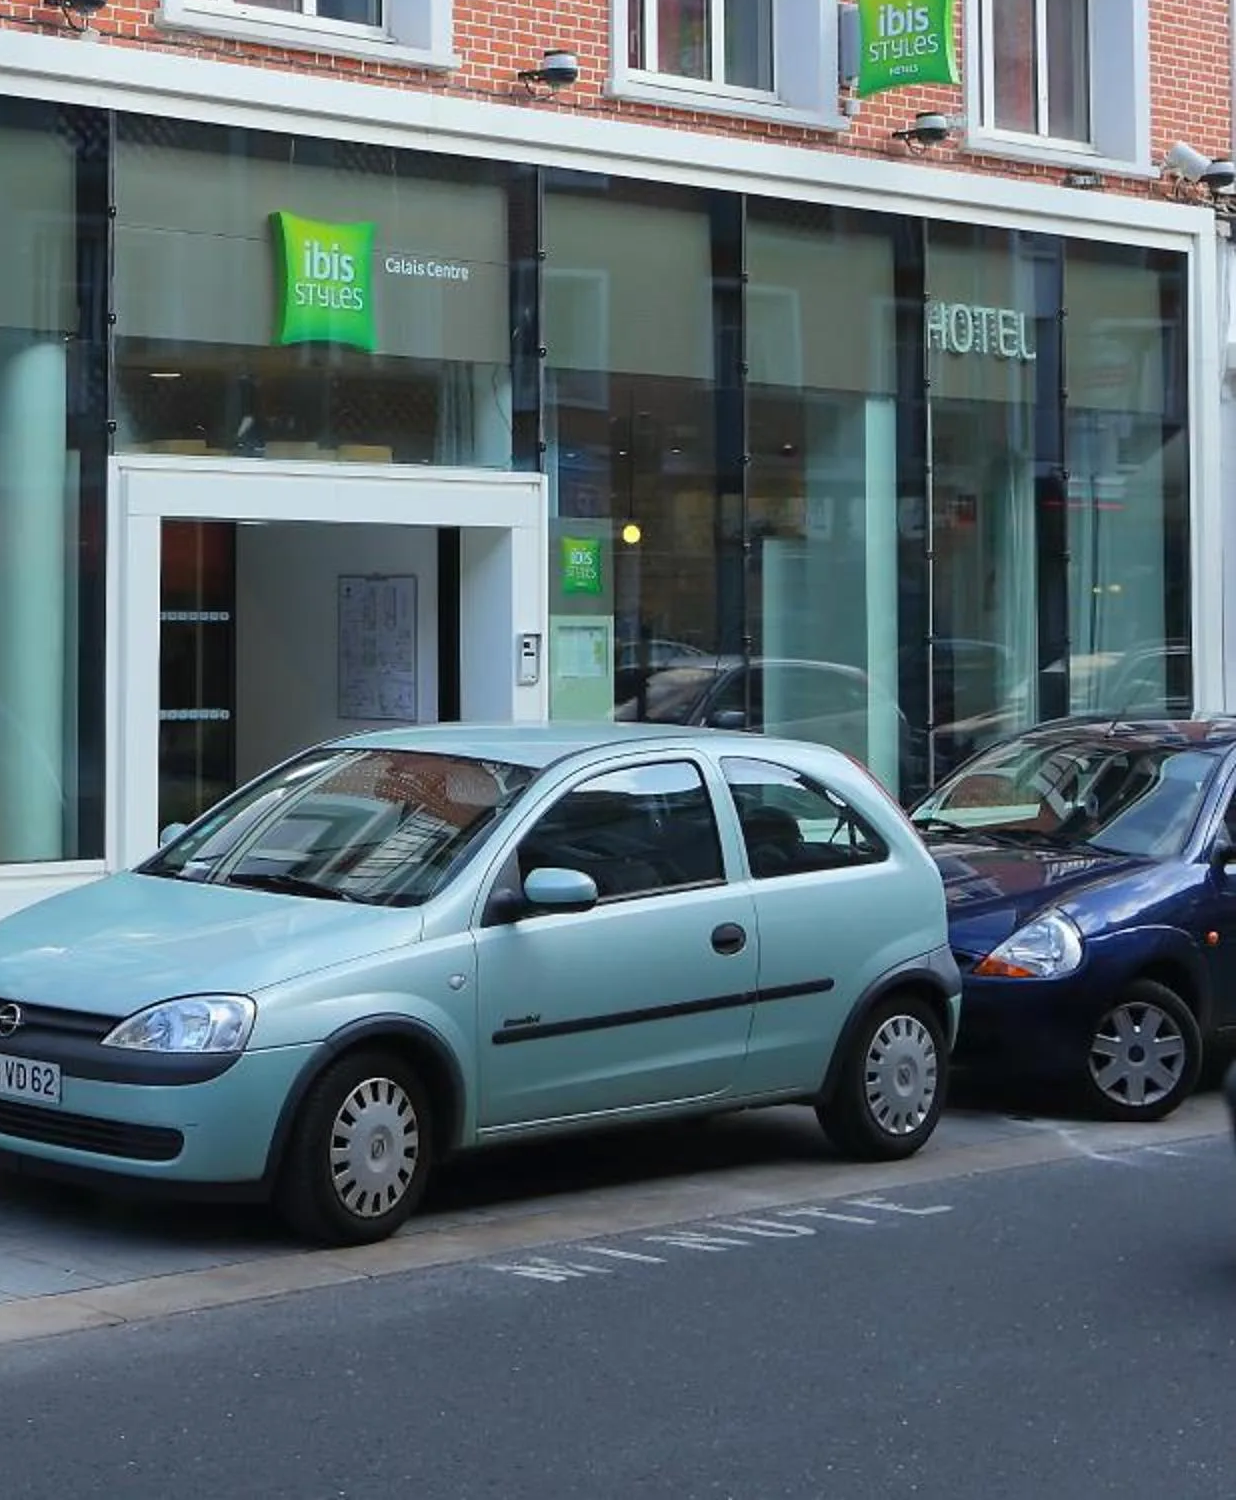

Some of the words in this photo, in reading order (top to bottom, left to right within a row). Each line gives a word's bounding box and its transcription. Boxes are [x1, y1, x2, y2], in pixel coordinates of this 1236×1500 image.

[879, 1, 929, 37] ibis
[303, 241, 355, 283] ibis
[385, 257, 425, 277] Calais
[427, 261, 469, 282] Centre
[928, 302, 1036, 360] HOTEL
[5, 1061, 27, 1090] VD
[31, 1066, 55, 1096] 62
[481, 1197, 954, 1283] MINUTE
